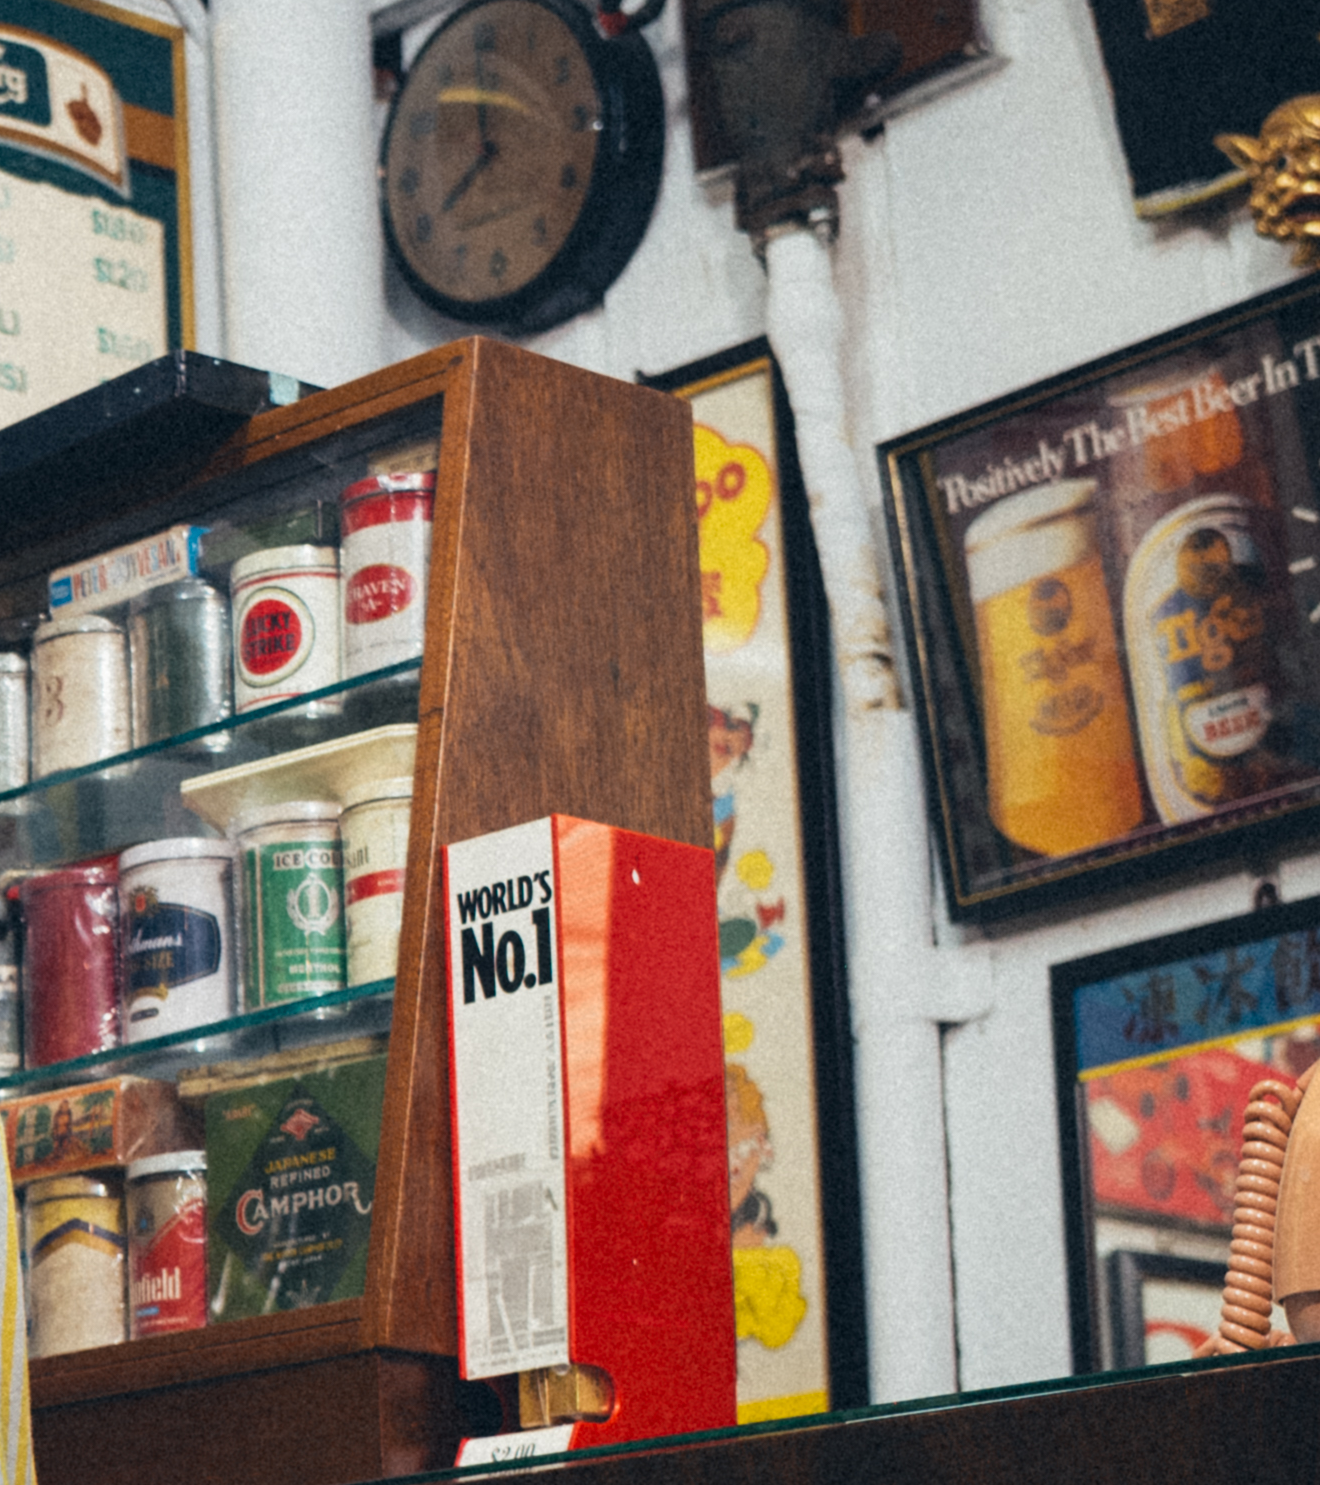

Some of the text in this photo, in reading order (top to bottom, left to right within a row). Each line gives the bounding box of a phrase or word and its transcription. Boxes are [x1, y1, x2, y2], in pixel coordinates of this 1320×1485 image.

[1063, 419, 1128, 466] The
[1124, 400, 1190, 446] Best
[1189, 376, 1263, 422] Beer
[1260, 352, 1301, 397] In
[245, 611, 293, 640] LUCKY
[242, 632, 296, 663] STRIKE
[275, 853, 302, 868] ICE
[456, 869, 553, 925] WORLD'S
[460, 906, 554, 1006] No.1
[264, 1147, 337, 1174] JAPANESE
[269, 1165, 331, 1190] REFINED
[235, 1181, 373, 1235] CAMPHOR
